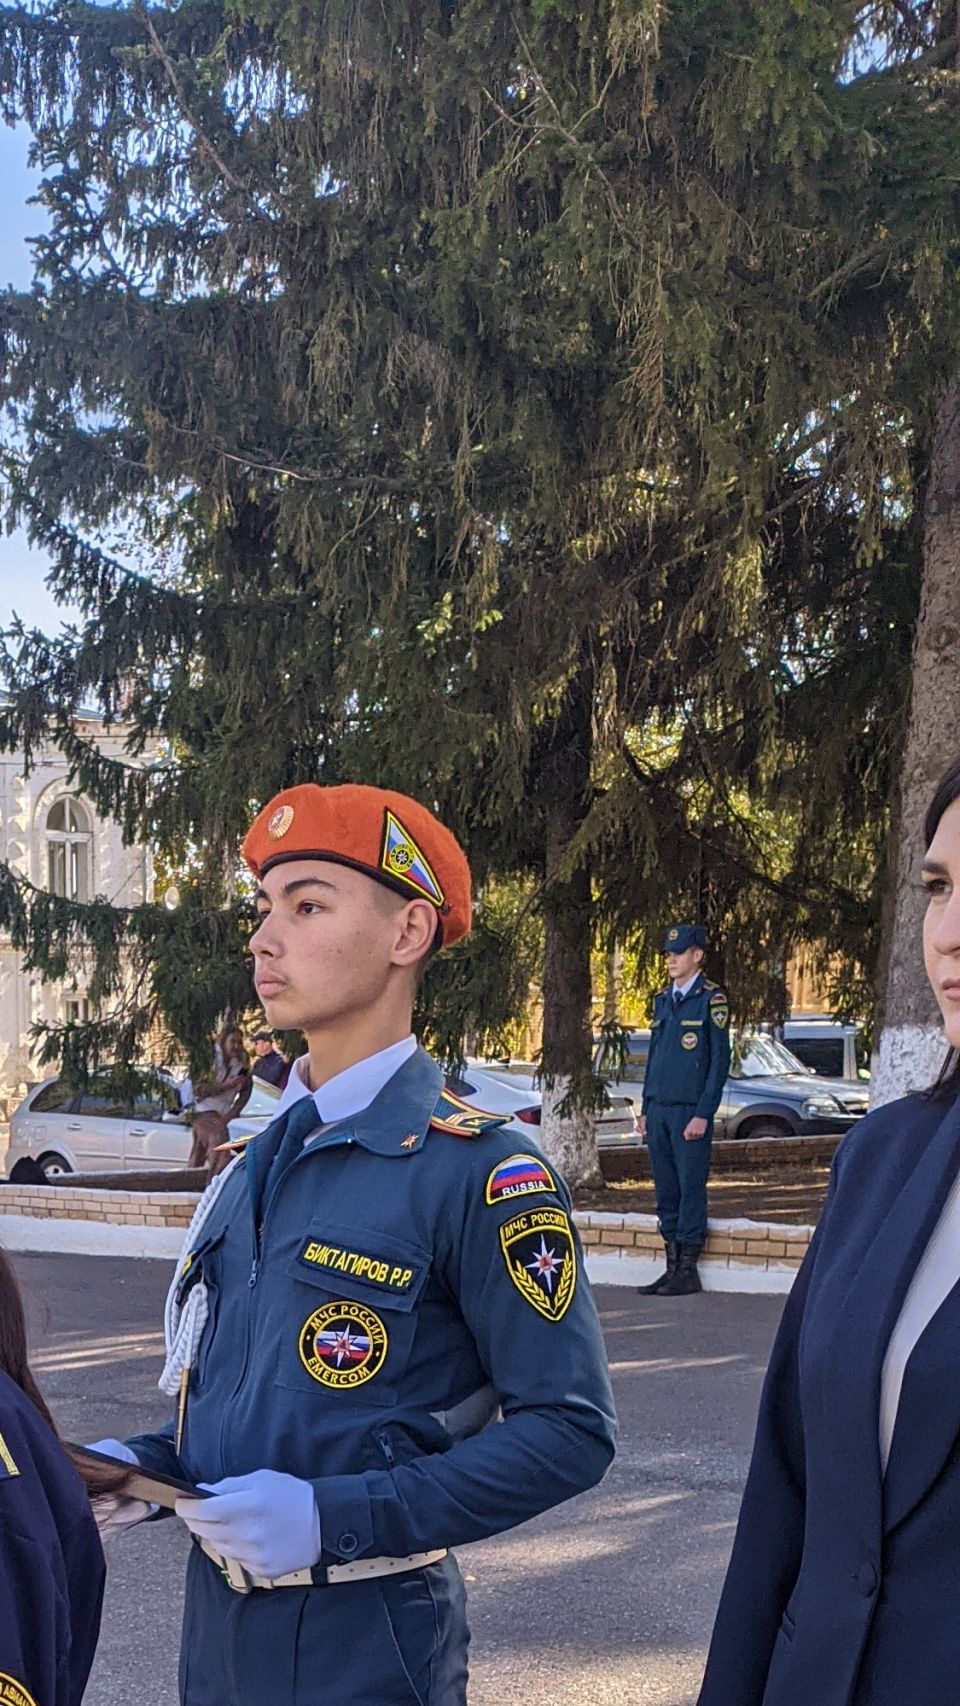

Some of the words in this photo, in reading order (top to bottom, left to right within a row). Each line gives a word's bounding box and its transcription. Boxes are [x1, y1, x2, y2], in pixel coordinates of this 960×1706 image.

[502, 1180, 546, 1196] RUSSIA
[504, 1217, 528, 1239] МЧС
[530, 1212, 566, 1227] РОССИИ
[304, 1242, 389, 1282] БИКТАГИРОВ
[310, 1306, 337, 1331] МЧС
[341, 1305, 384, 1344] РОССИИ
[307, 1357, 371, 1384] EMERCOM
